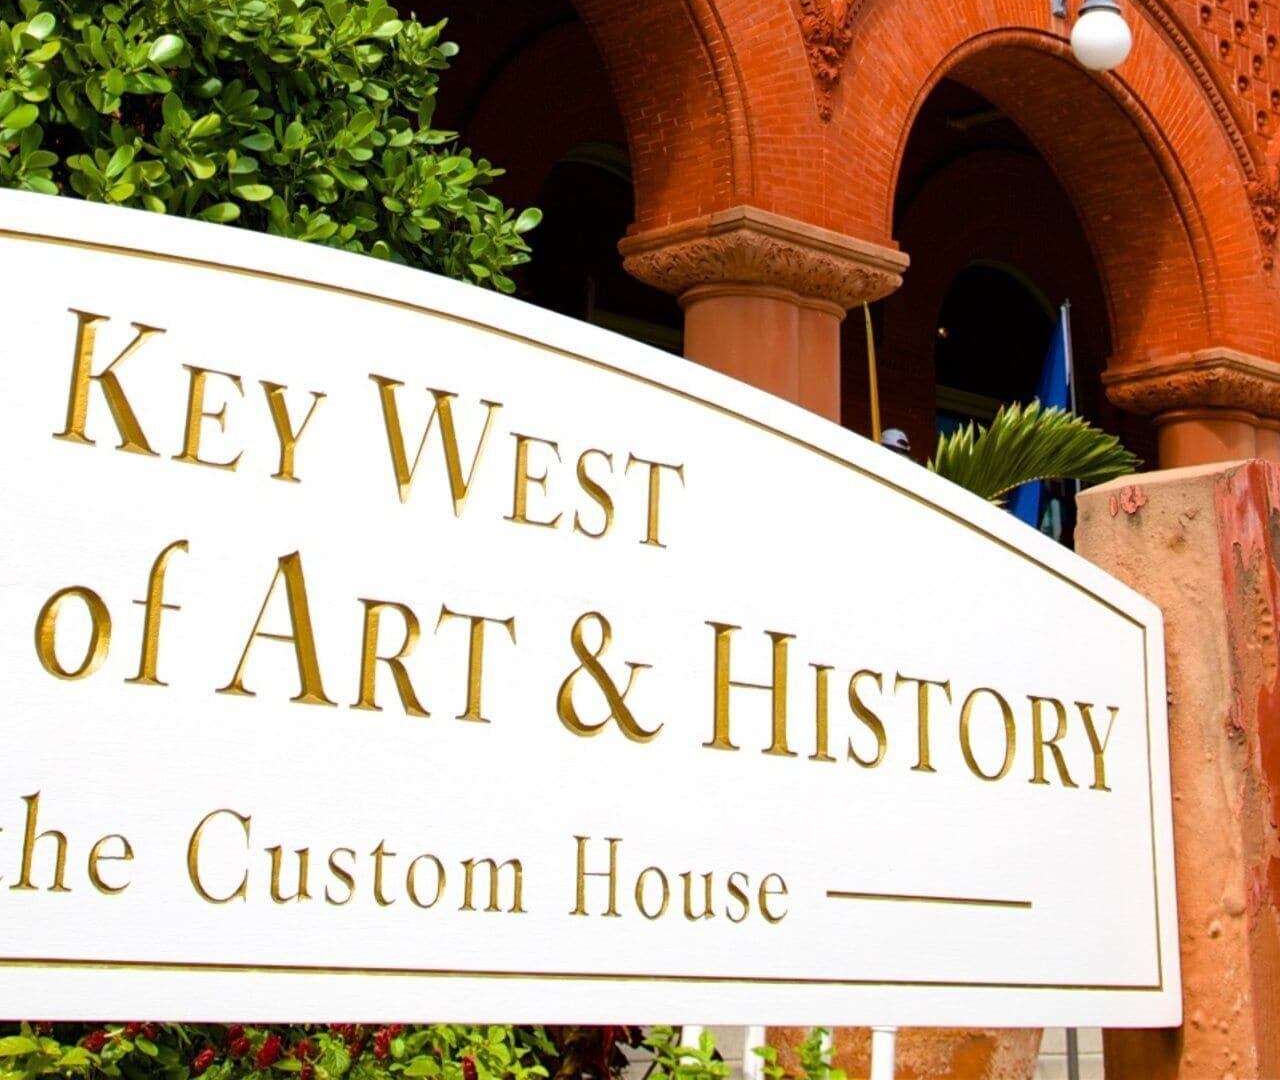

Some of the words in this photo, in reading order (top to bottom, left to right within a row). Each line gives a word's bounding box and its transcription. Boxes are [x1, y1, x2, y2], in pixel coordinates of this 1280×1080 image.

[53, 308, 326, 483] KEY
[369, 374, 684, 547] WEST
[35, 540, 189, 686] of
[216, 551, 516, 723] ART
[557, 612, 663, 744] &
[702, 621, 1119, 792] HISTORY
[187, 810, 528, 913] Custom
[570, 836, 789, 924] House
